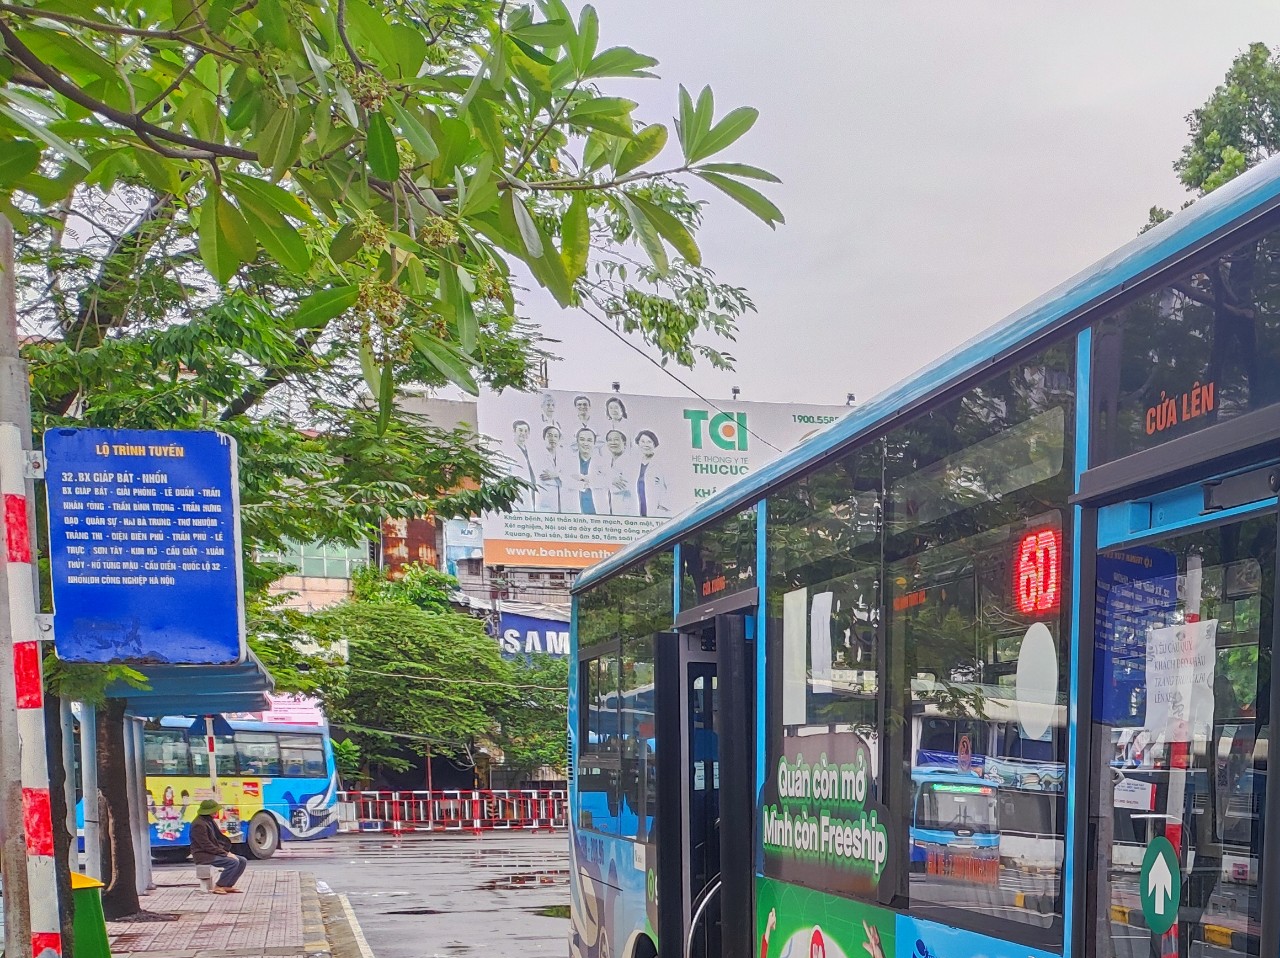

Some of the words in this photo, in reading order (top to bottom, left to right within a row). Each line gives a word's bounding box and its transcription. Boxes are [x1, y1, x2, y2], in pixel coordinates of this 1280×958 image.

[683, 408, 748, 451] TCI
[1146, 390, 1177, 435] CỬA
[1182, 381, 1215, 422] LÊN
[95, 441, 110, 457] LỘ
[112, 442, 146, 456] TRÌNH
[148, 442, 184, 457] TUYẾN
[62, 486, 72, 495] BX
[75, 486, 91, 495] GIÁP
[94, 486, 108, 496] BÁT
[93, 470, 114, 483] GIÁP
[117, 470, 134, 483] BÁT
[211, 563, 221, 571] 32
[1020, 531, 1056, 612] 6D
[779, 759, 811, 798] Quán
[812, 758, 838, 799] còn
[841, 754, 866, 802] mở
[764, 809, 793, 848] Mình
[794, 811, 818, 851] còn
[821, 815, 886, 874] Freeship
